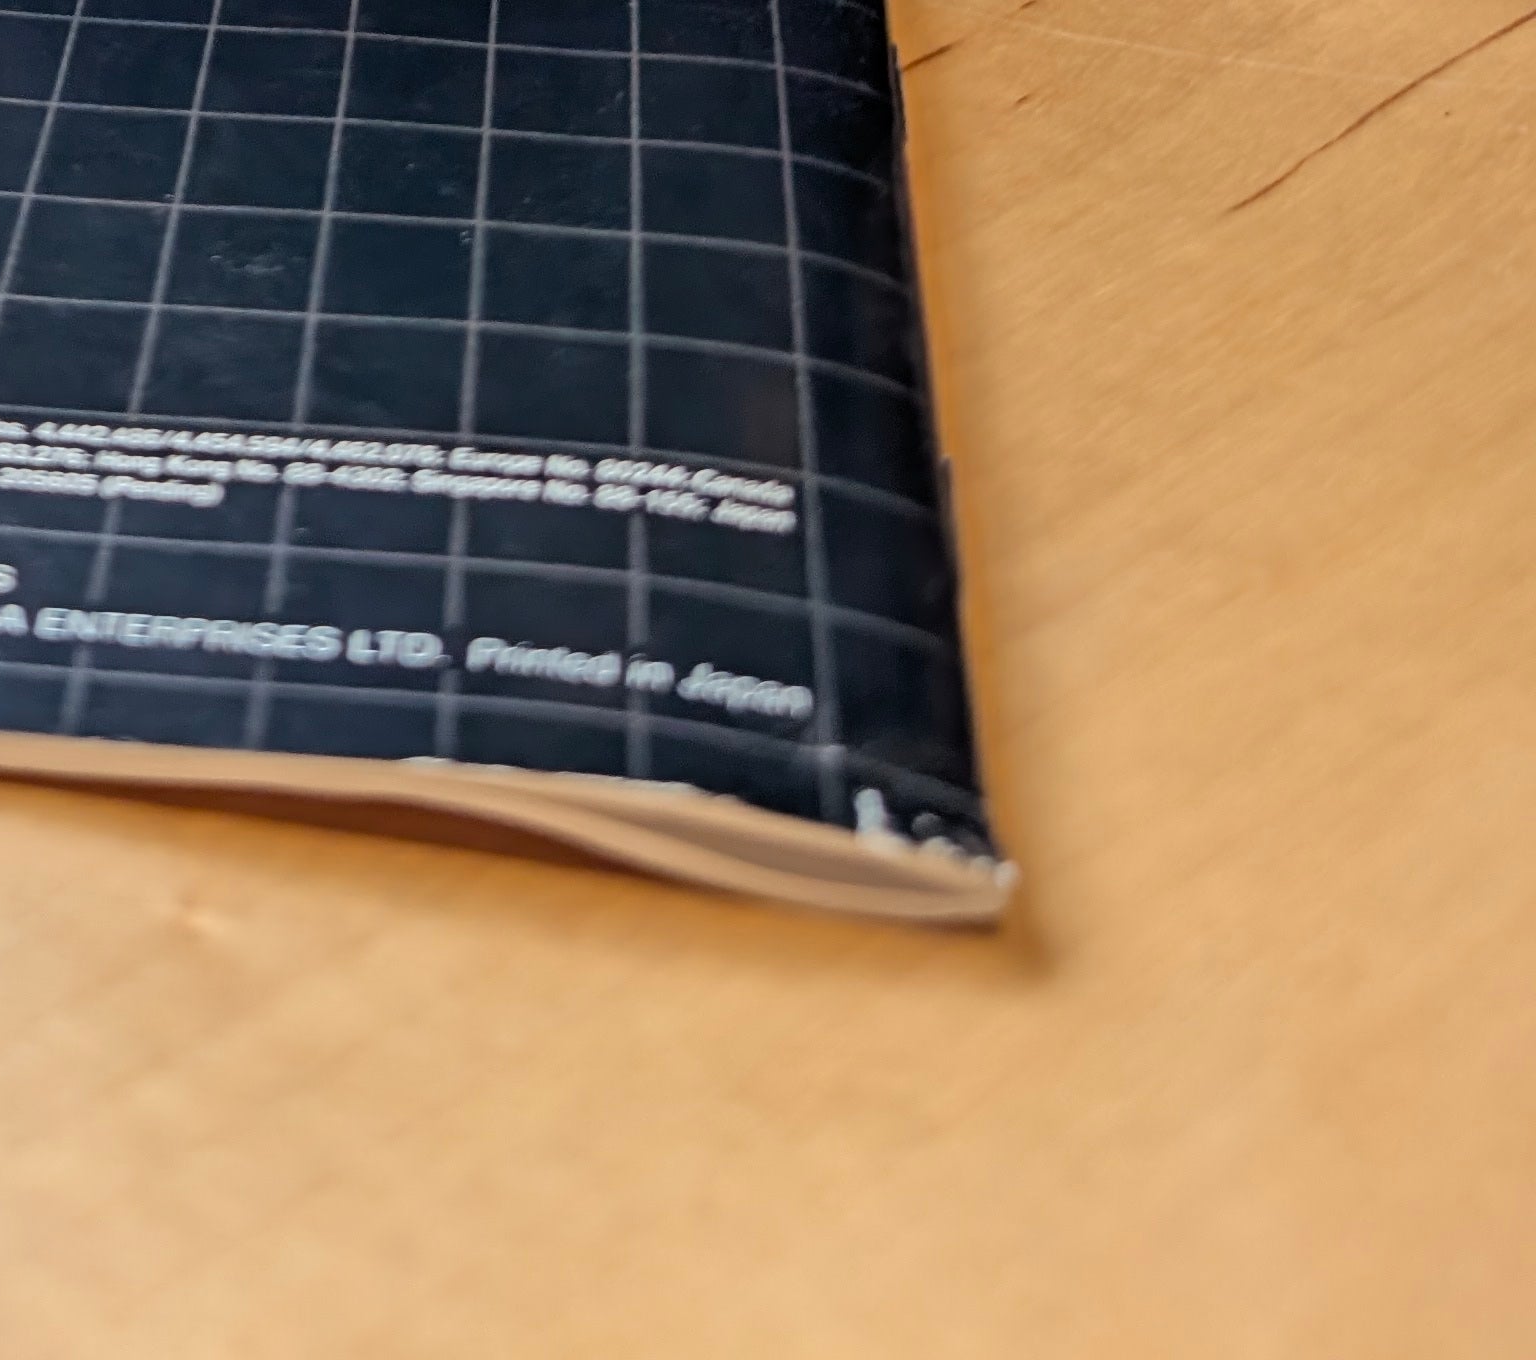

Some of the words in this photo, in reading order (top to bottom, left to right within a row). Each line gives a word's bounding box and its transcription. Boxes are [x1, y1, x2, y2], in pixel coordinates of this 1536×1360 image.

[34, 606, 344, 661] ENTERPRISES
[345, 628, 454, 668] LTD.
[466, 636, 623, 686] Printed
[625, 652, 676, 693] in
[676, 662, 815, 720] Japan
